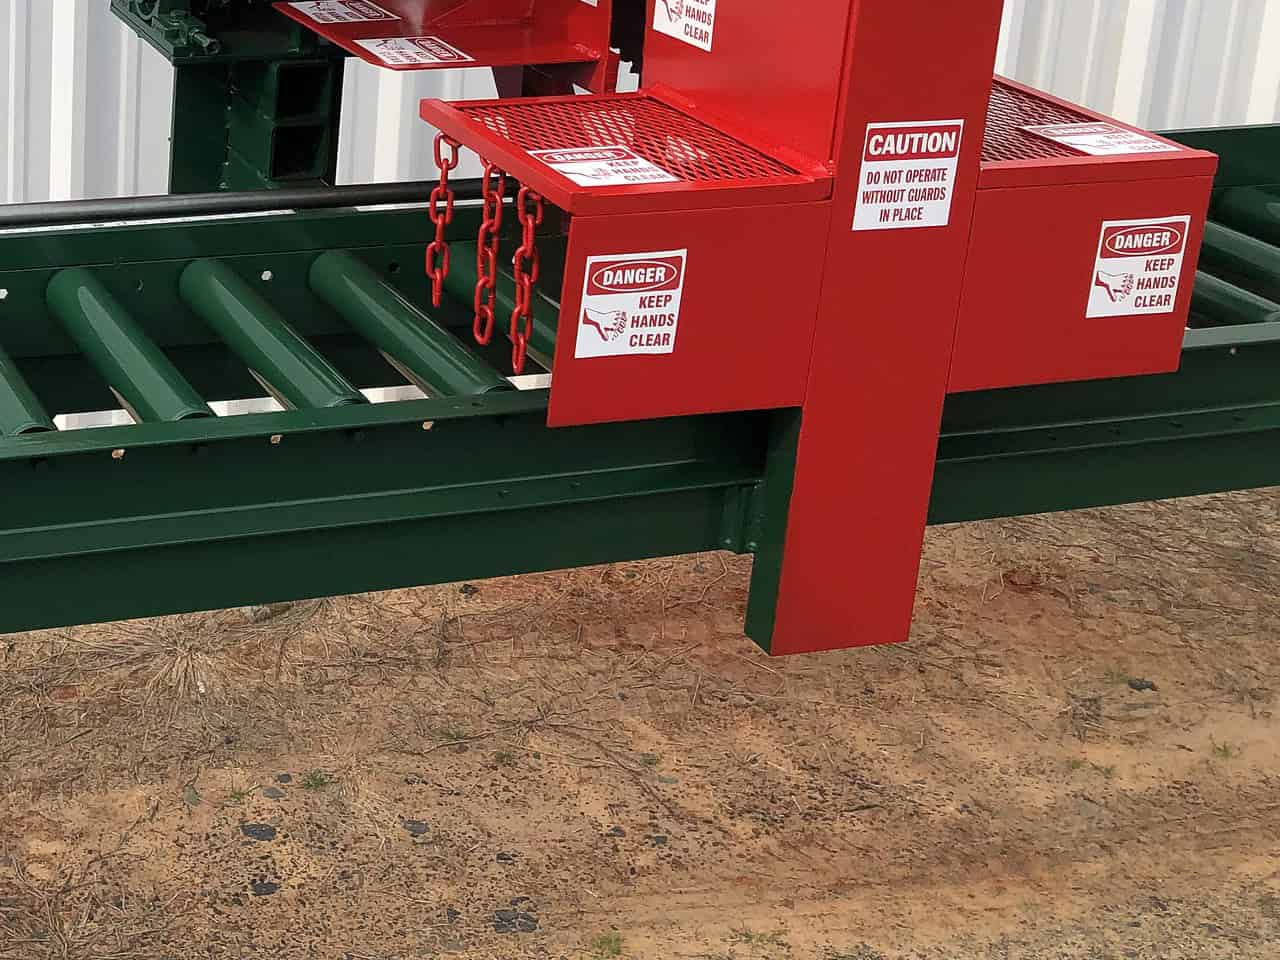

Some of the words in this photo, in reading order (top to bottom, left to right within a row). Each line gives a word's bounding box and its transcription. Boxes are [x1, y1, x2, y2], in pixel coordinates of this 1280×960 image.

[685, 5, 712, 26] HANDS
[684, 23, 709, 44] CLEAR
[868, 131, 957, 156] CAUTION
[866, 171, 881, 185] DO
[883, 170, 904, 184] NOT
[905, 168, 948, 183] OPERATE
[862, 189, 906, 204] WITHOUT
[907, 187, 947, 202] GUARDS
[879, 208, 890, 222] IN
[892, 207, 924, 221] PLACE
[1114, 231, 1171, 250] DANGER
[1144, 258, 1175, 272] KEEP
[602, 266, 666, 286] DANGER
[1136, 276, 1176, 290] HANDS
[639, 294, 673, 309] KEEP
[1134, 294, 1171, 308] CLEAR
[630, 313, 675, 328] HANDS
[629, 333, 671, 347] CLEAR
